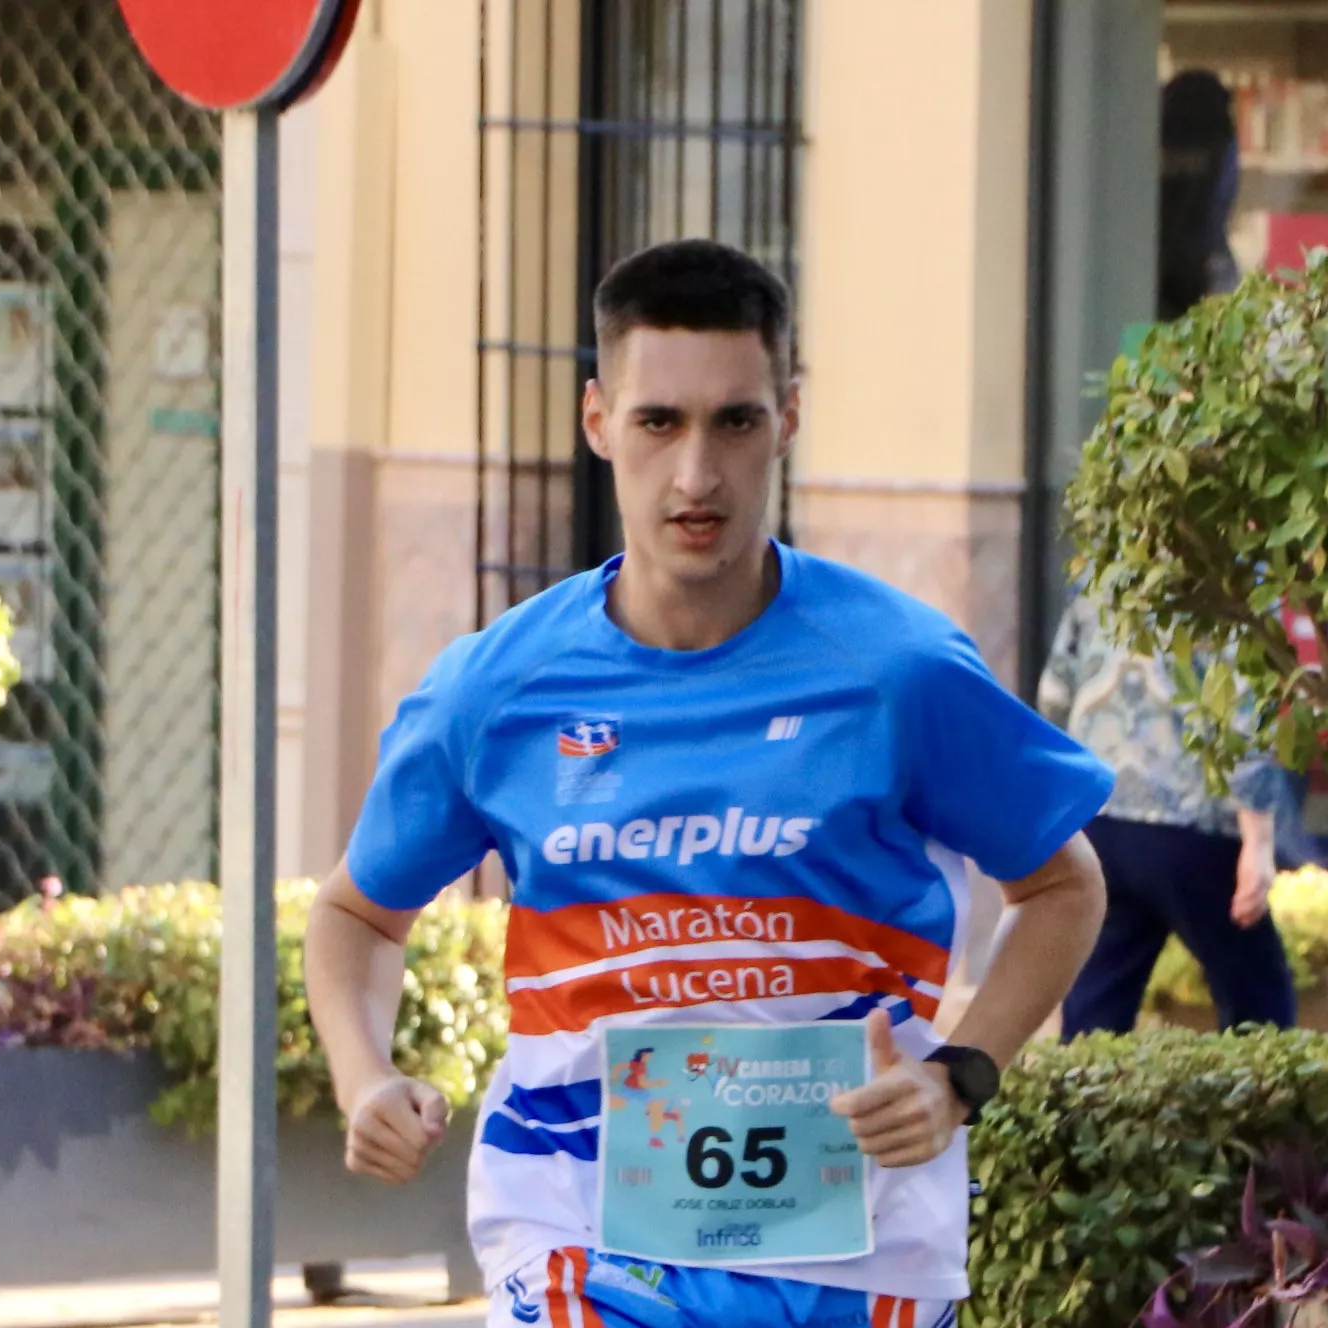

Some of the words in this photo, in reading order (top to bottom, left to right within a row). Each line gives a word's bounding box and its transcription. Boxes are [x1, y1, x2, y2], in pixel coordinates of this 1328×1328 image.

[543, 806, 815, 865] enerplus
[598, 901, 795, 949] Maratón
[621, 964, 794, 1004] Lucena
[686, 1126, 788, 1188] 65
